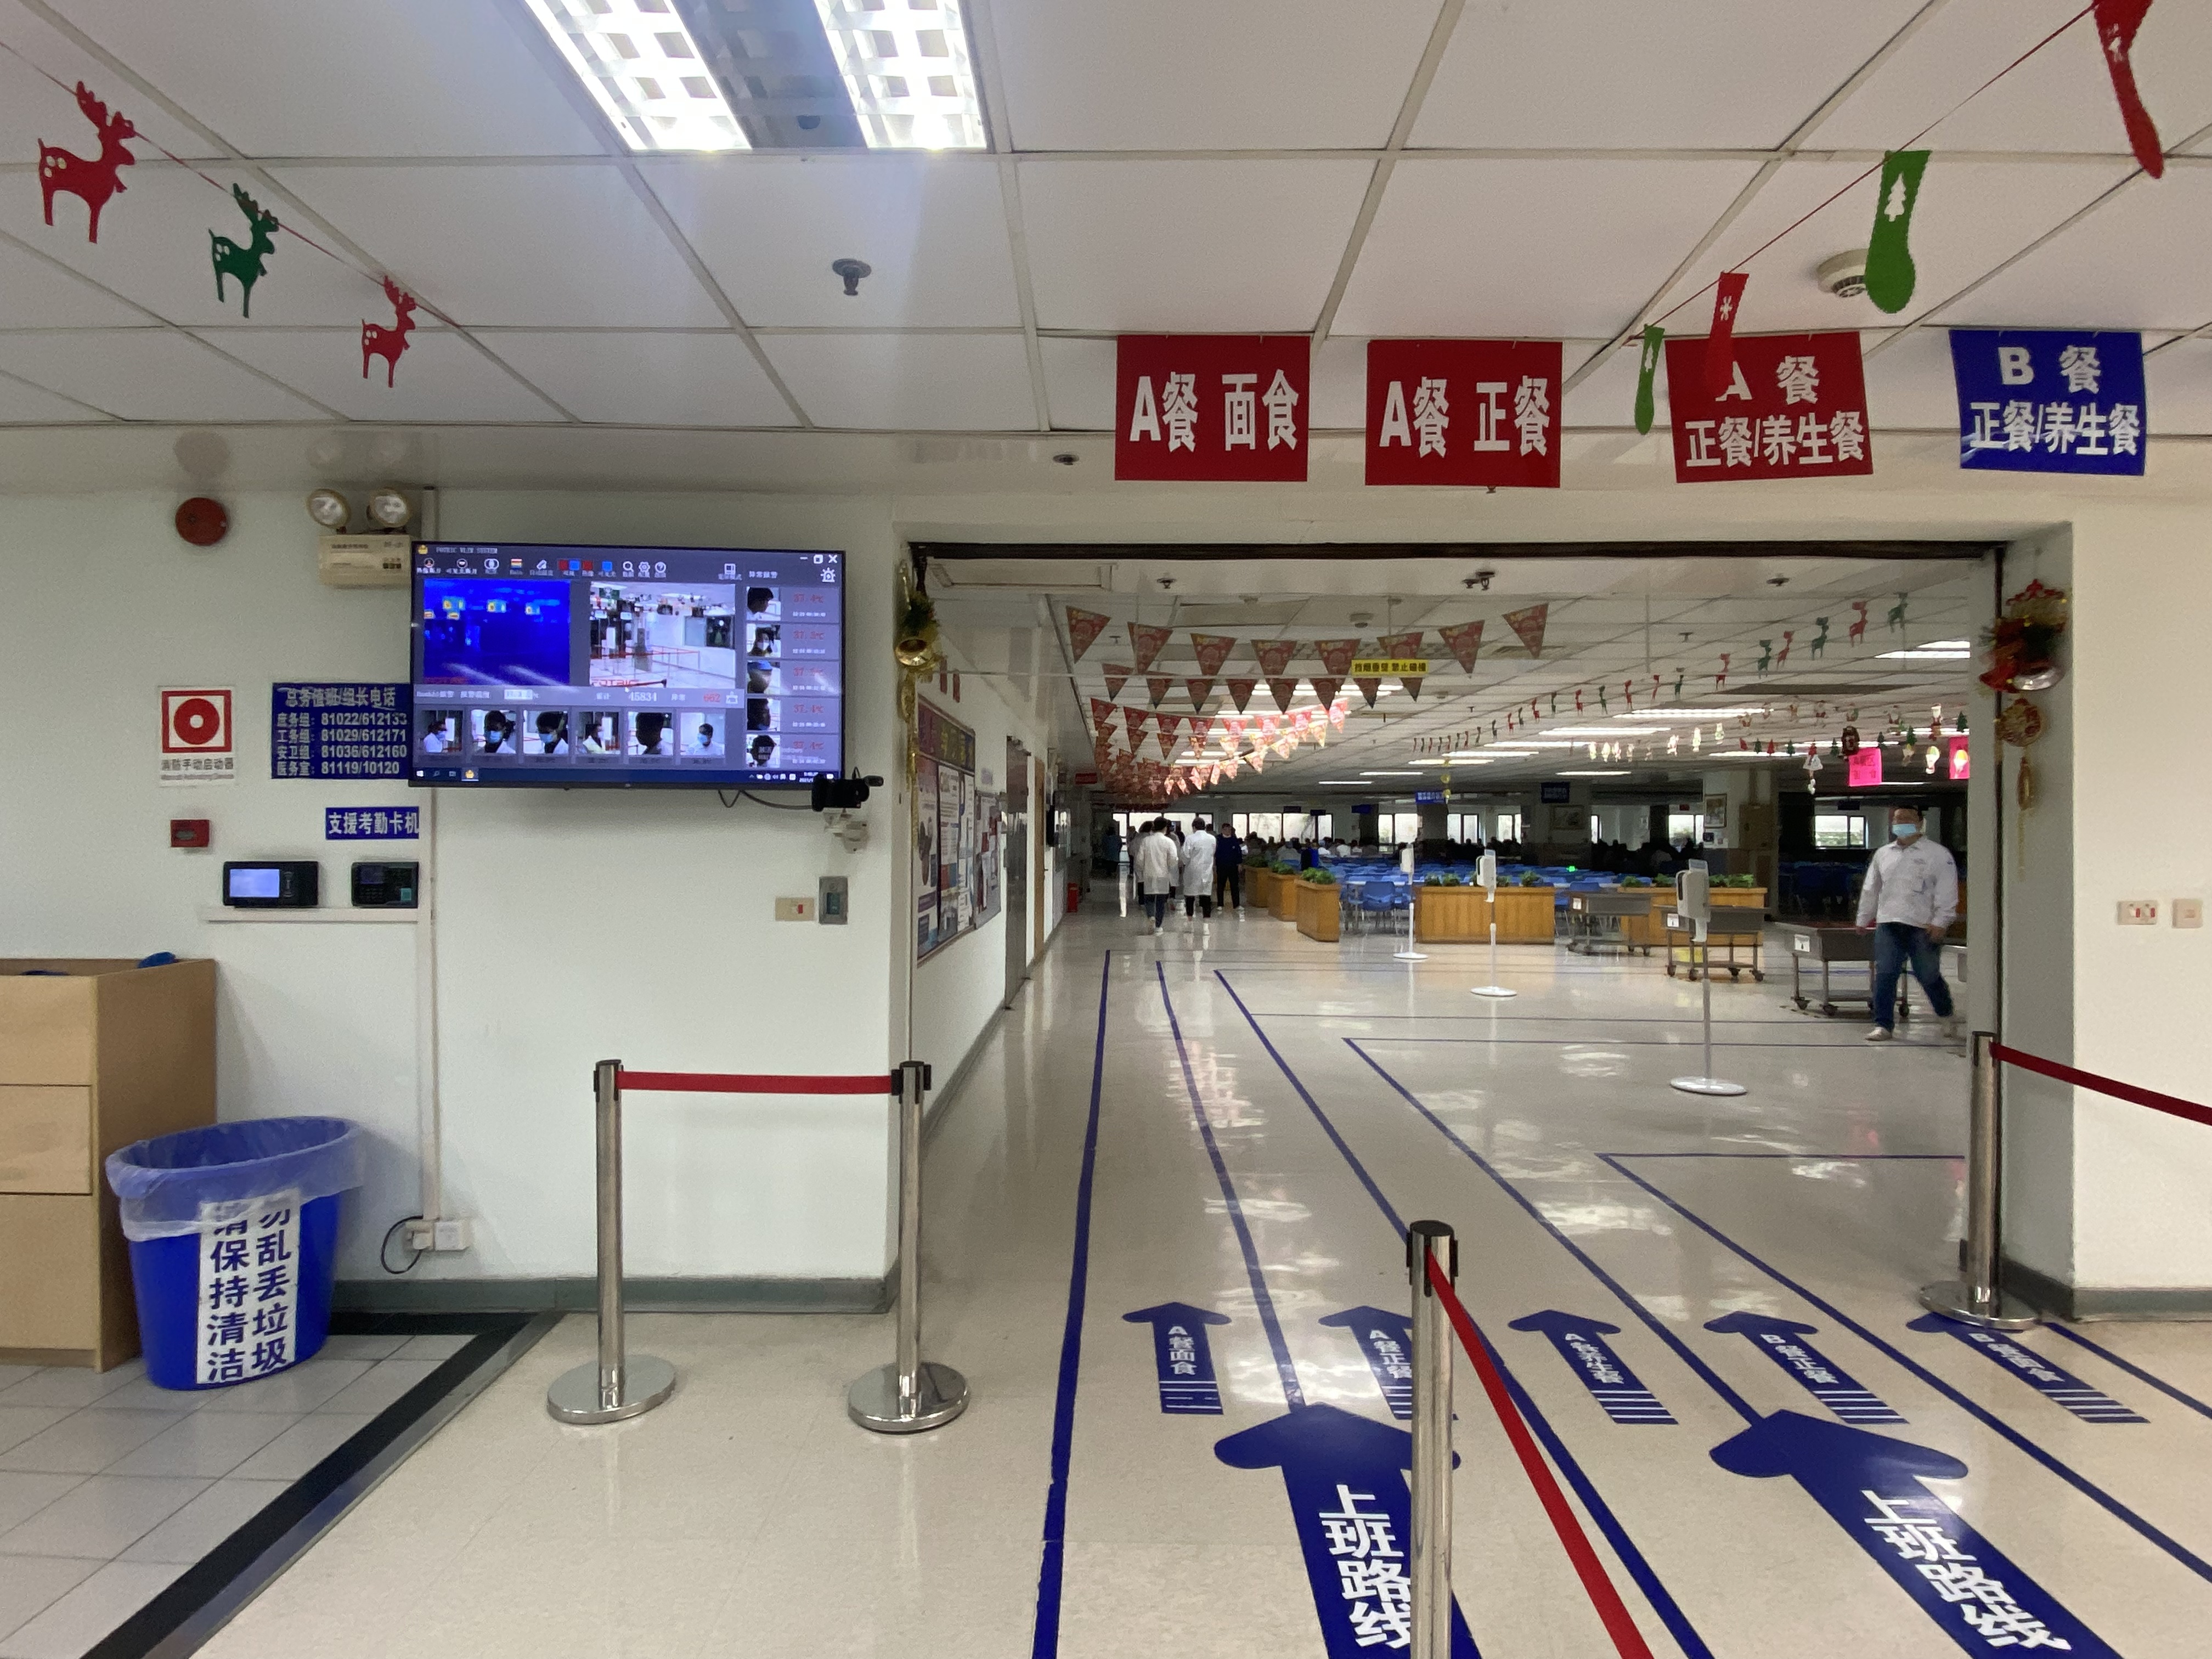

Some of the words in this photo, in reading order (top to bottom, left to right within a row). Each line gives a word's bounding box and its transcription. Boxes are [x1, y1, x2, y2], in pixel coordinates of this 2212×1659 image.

[1776, 356, 1820, 405] 餐
[1999, 347, 2034, 385] B
[2059, 344, 2103, 394] 餐
[1129, 371, 1199, 453] A餐
[1221, 369, 1299, 451] 面食
[1379, 376, 1450, 458] A餐
[1474, 375, 1550, 457] 正餐
[1970, 400, 2140, 457] 正餐/养生餐
[1685, 411, 1864, 467] 正餐/养生餐
[321, 729, 406, 742] 81029/612171
[321, 745, 407, 758] 81036/612160
[321, 761, 399, 774] 81119/10120
[329, 811, 420, 834] 支援考勤卡机
[1168, 1325, 1197, 1375] A餐面食
[1319, 1484, 1410, 1649] 上班路线
[1861, 1490, 2073, 1651] 上班路线
